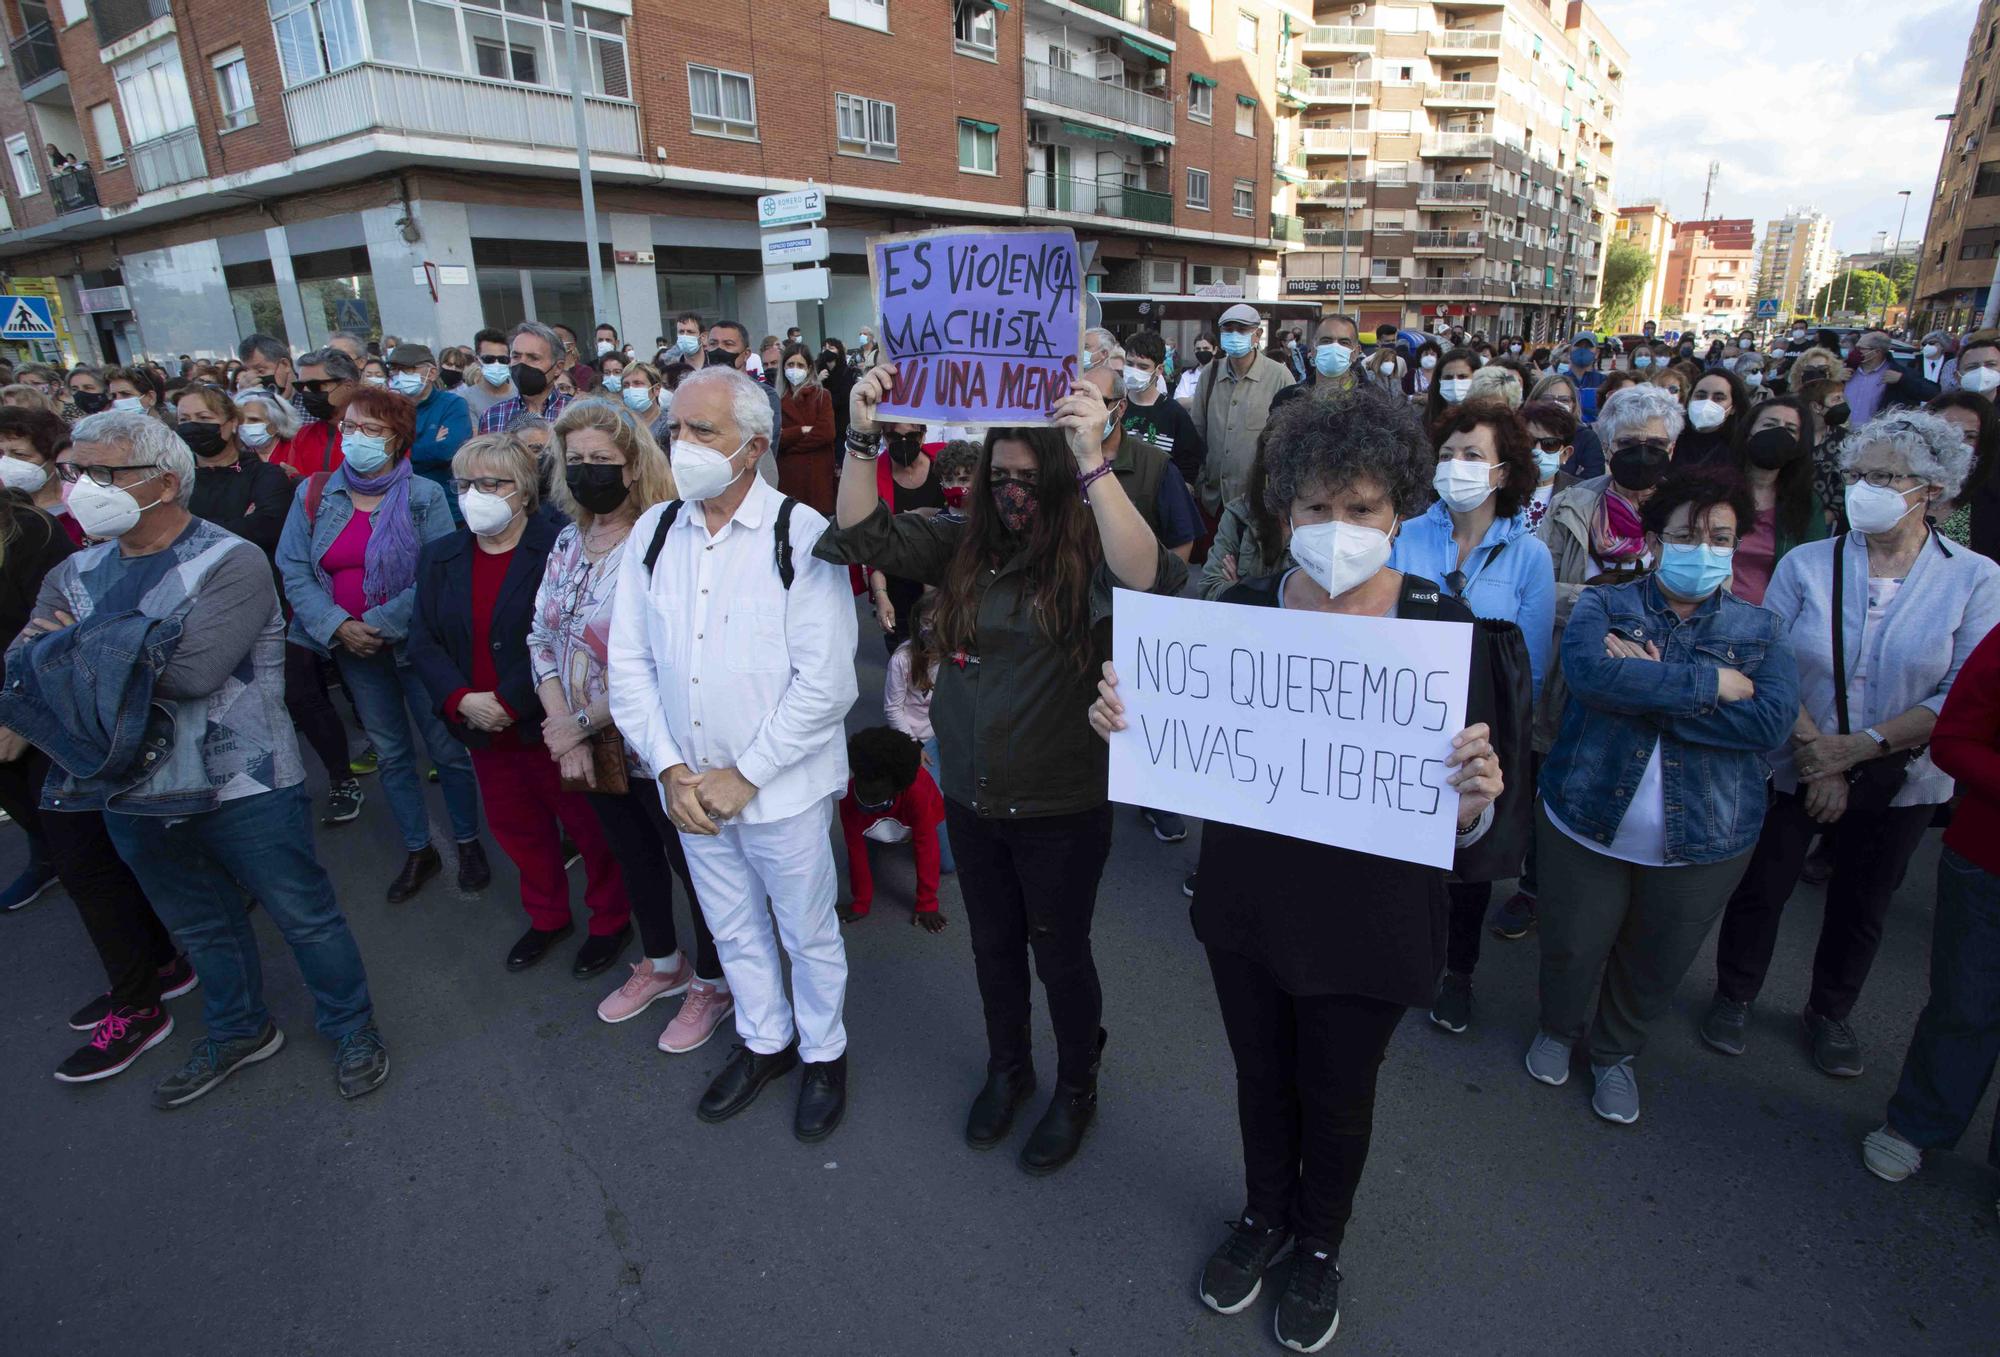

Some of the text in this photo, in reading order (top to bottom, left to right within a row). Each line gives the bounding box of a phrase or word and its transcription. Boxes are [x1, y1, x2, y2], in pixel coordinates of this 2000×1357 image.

[884, 241, 932, 298] ES
[1289, 281, 1310, 291] mdg
[935, 358, 988, 409] UNA
[1136, 636, 1449, 732] NOS QUEREMOS
[1140, 714, 1445, 815] VIVAS y LIBRES
